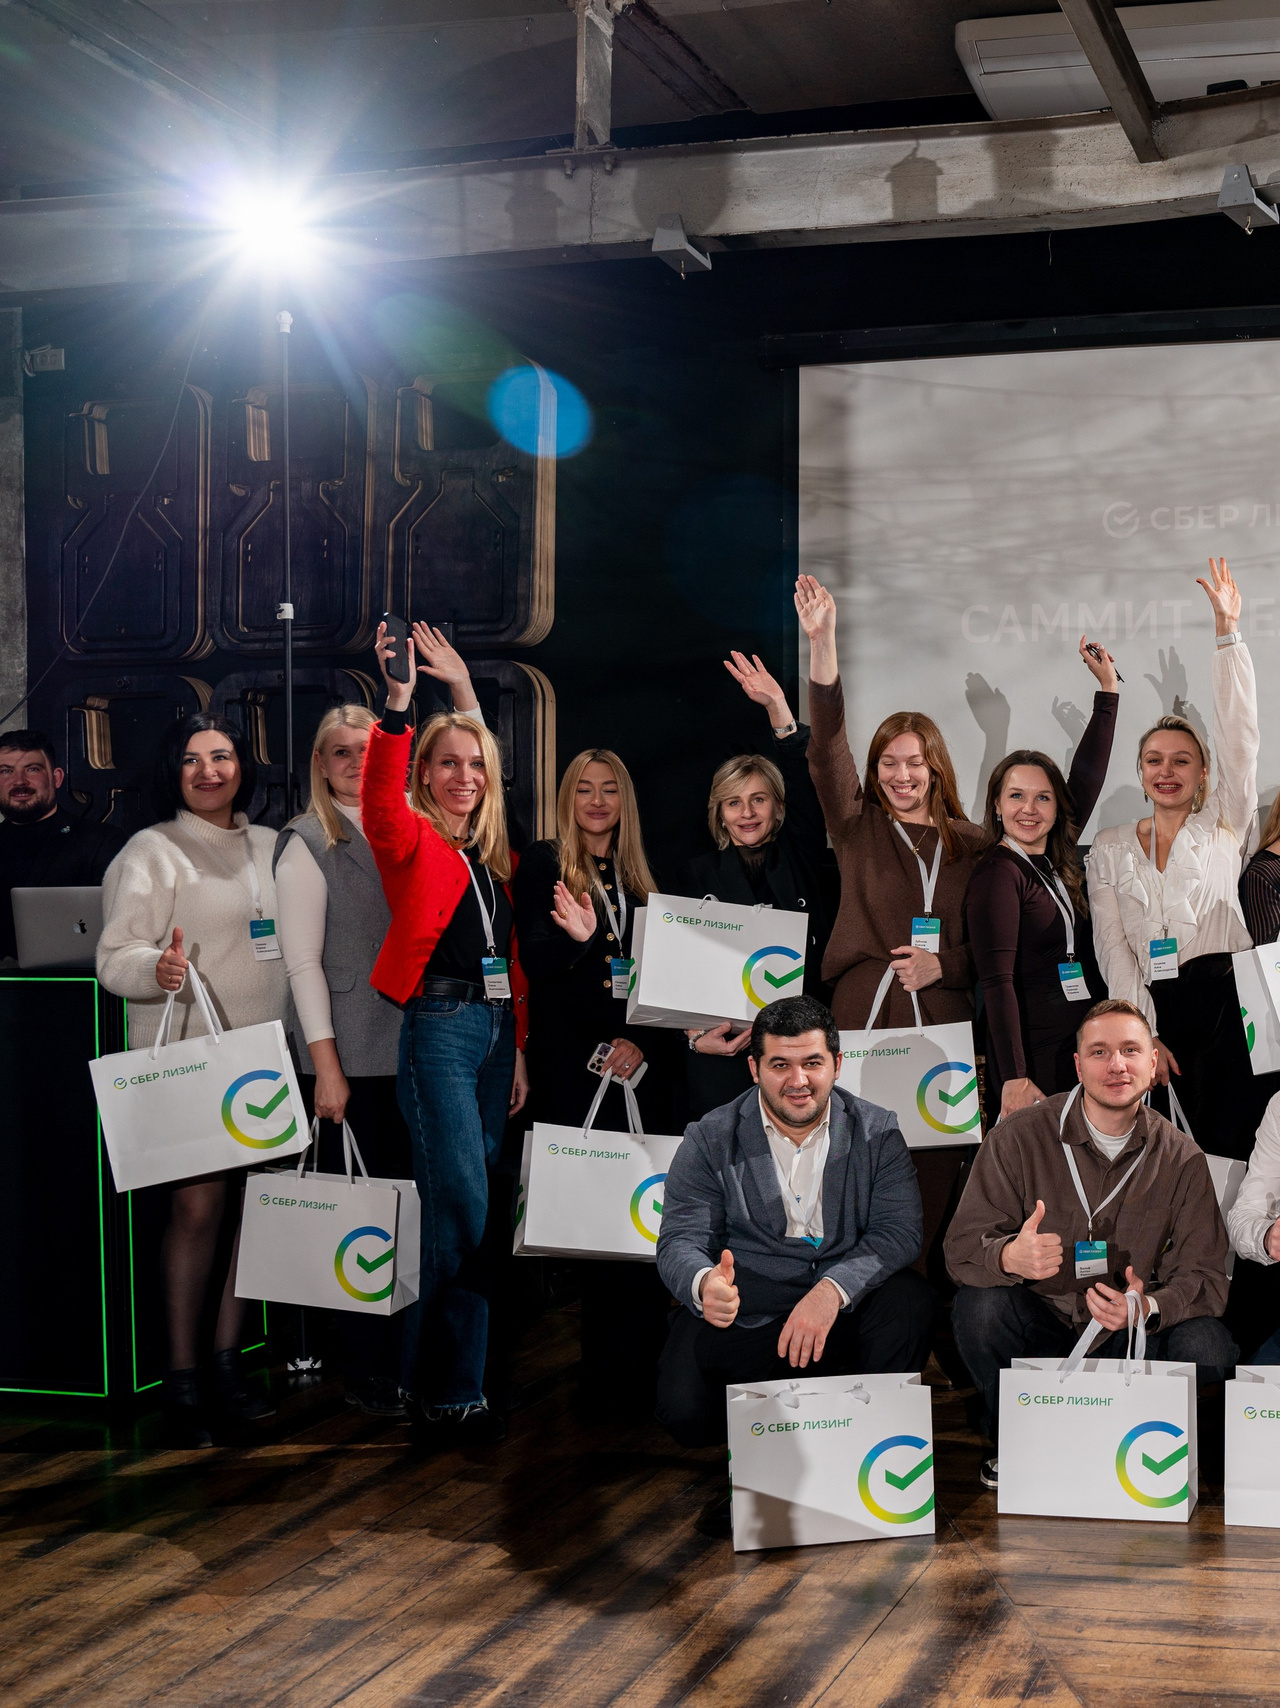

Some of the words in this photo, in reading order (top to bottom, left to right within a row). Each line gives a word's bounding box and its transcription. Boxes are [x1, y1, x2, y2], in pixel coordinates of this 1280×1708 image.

[1150, 504, 1239, 531] СБЕР
[961, 600, 1192, 643] САММИТ
[676, 916, 702, 925] СБЕР
[703, 920, 744, 931] ЛИЗИНГ
[843, 1050, 869, 1058] СБЕР
[871, 1047, 911, 1057] ЛИЗИНГ
[130, 1072, 160, 1085] СБЕР
[162, 1061, 208, 1079] ЛИЗИНГ
[561, 1147, 587, 1156] СБЕР
[589, 1150, 631, 1160] ЛИЗИНГ
[272, 1197, 297, 1206] СБЕР
[298, 1200, 338, 1211] ЛИЗИНГ
[1034, 1395, 1064, 1404] СБЕР
[1066, 1396, 1113, 1406] ЛИЗИНГ
[768, 1422, 800, 1433] СБЕР
[802, 1418, 852, 1430] ЛИЗИНГ
